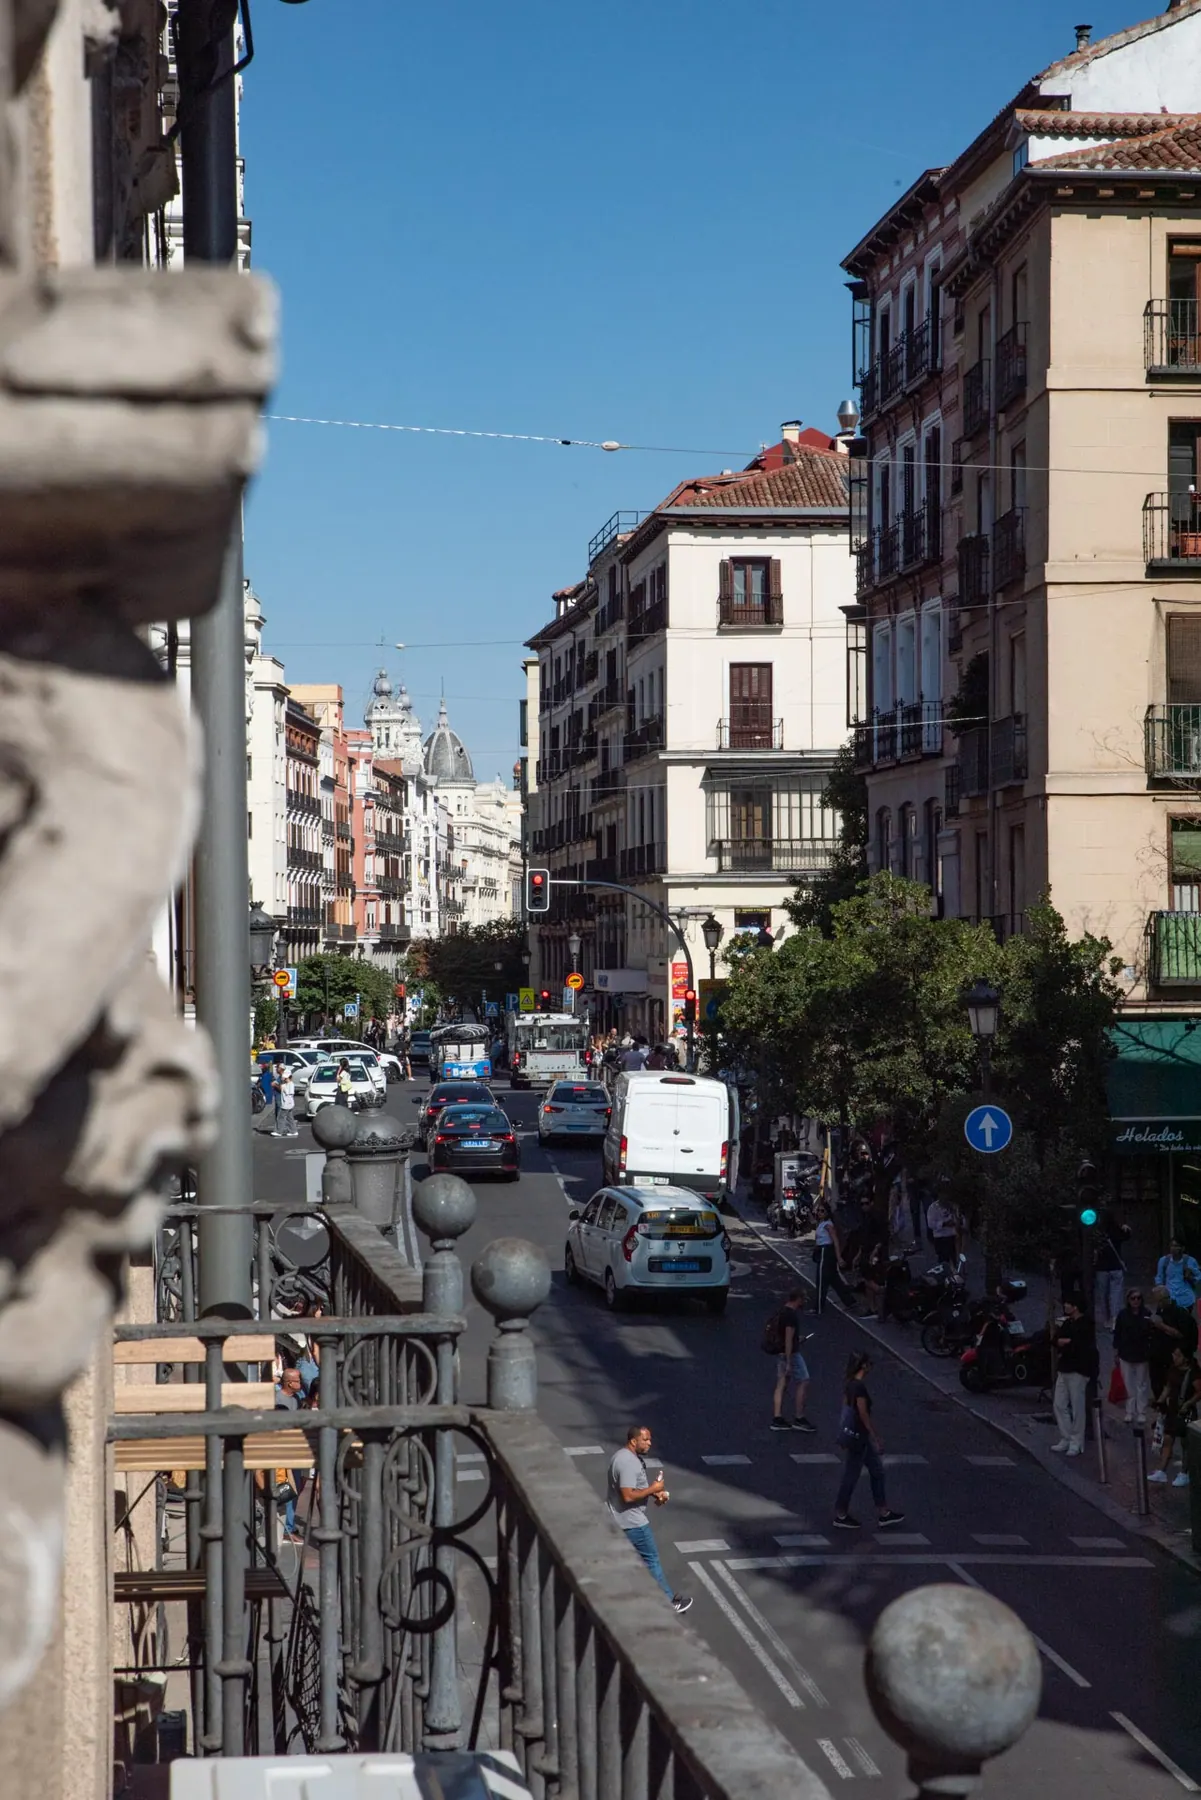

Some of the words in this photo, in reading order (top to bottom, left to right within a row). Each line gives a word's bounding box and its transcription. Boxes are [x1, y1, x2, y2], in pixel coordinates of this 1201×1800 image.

[509, 994, 519, 1010] P
[1116, 1126, 1184, 1142] Helados
[648, 1241, 653, 1250] L
